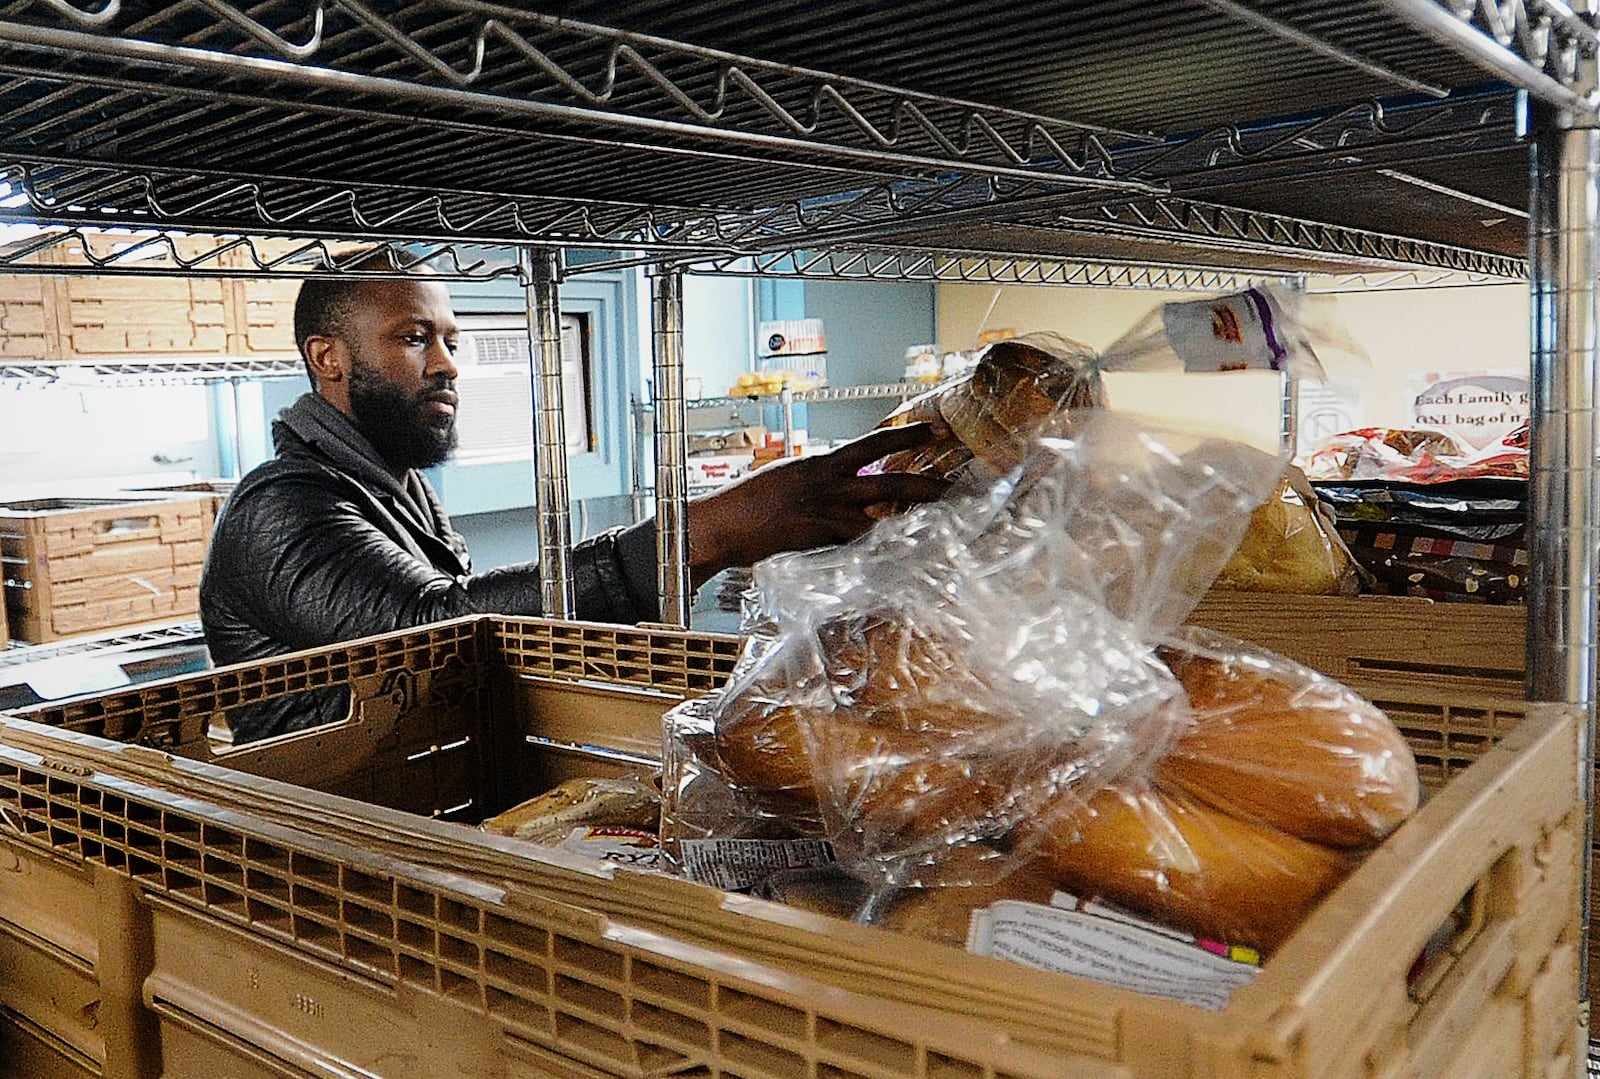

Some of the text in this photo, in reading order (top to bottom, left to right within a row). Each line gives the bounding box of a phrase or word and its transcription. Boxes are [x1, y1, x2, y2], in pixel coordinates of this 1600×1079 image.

[1415, 394, 1453, 406] Each
[1459, 391, 1512, 405] Family
[1416, 415, 1450, 425] ONE
[1455, 414, 1485, 426] bag
[1489, 412, 1506, 423] of
